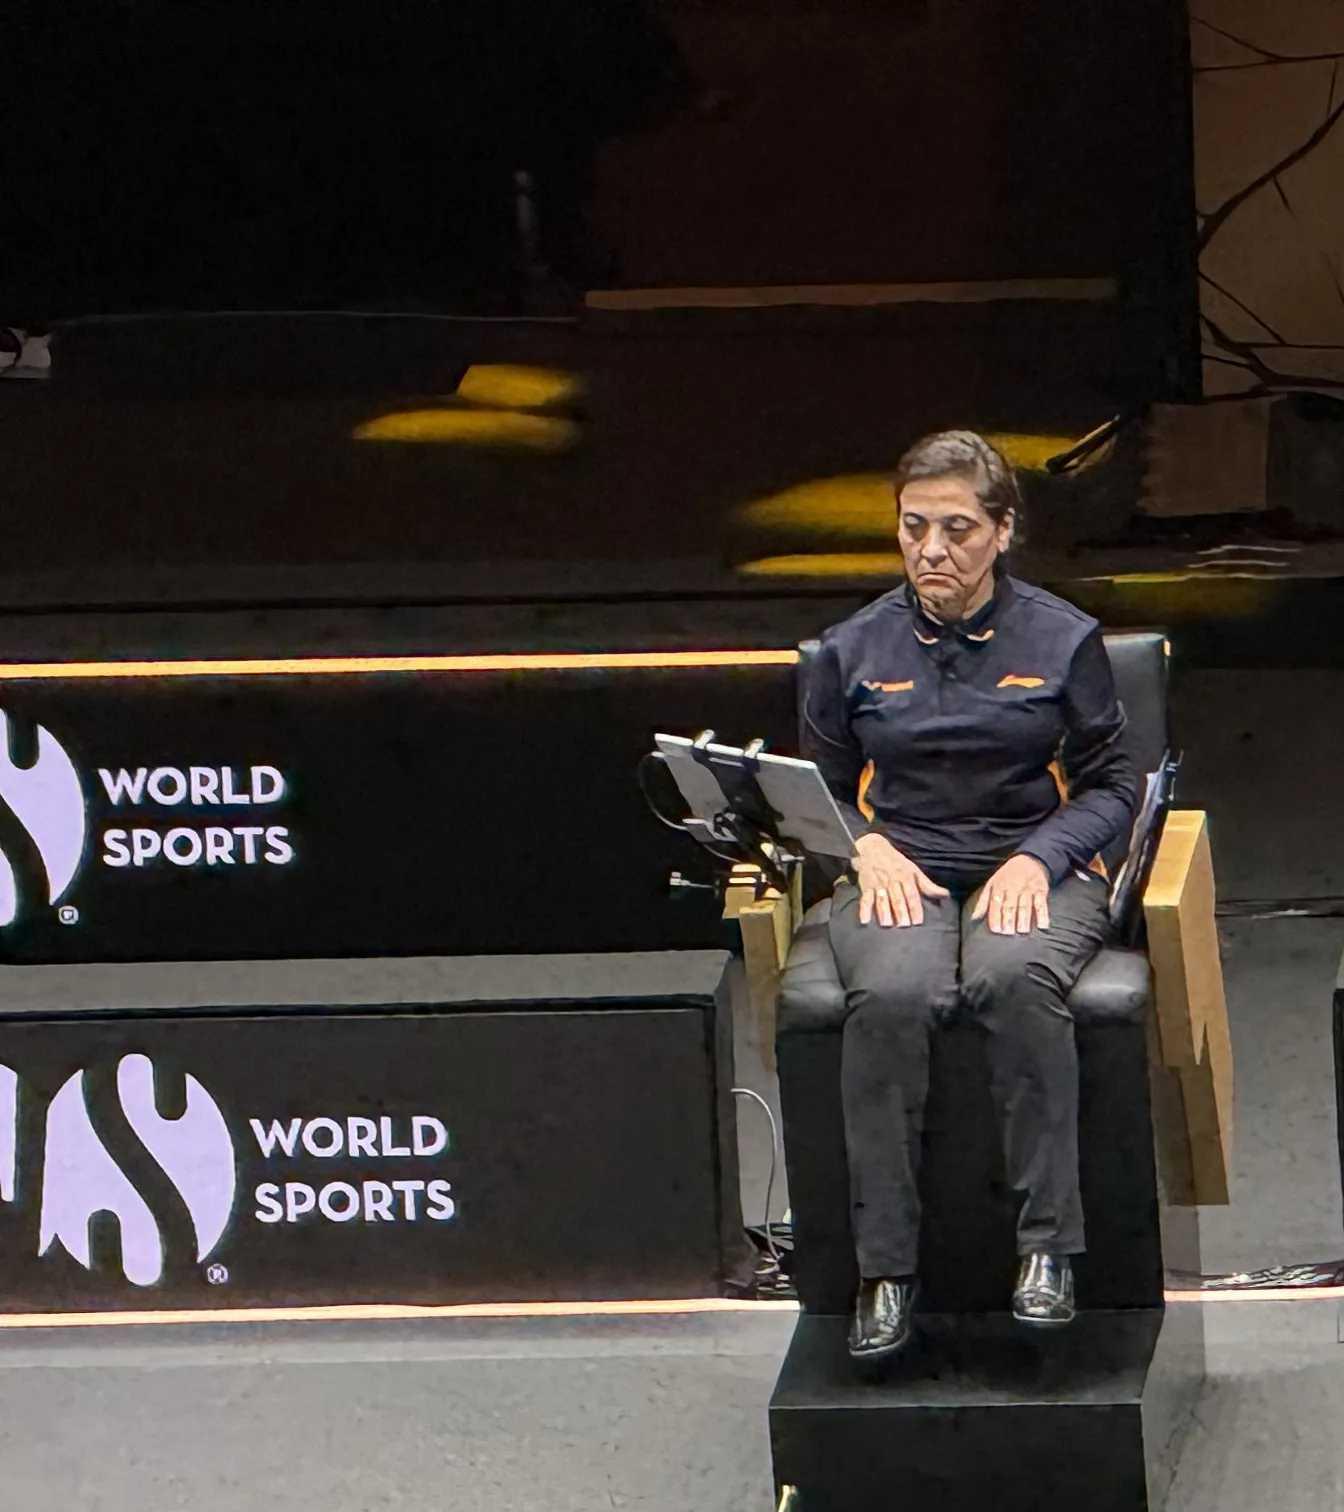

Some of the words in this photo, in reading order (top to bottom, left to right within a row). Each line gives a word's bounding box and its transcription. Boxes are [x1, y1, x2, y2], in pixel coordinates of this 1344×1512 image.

[98, 765, 285, 806] WORLD
[102, 826, 293, 867] SPORTS
[249, 1115, 448, 1159] WORLD
[255, 1179, 455, 1223] SPORTS
